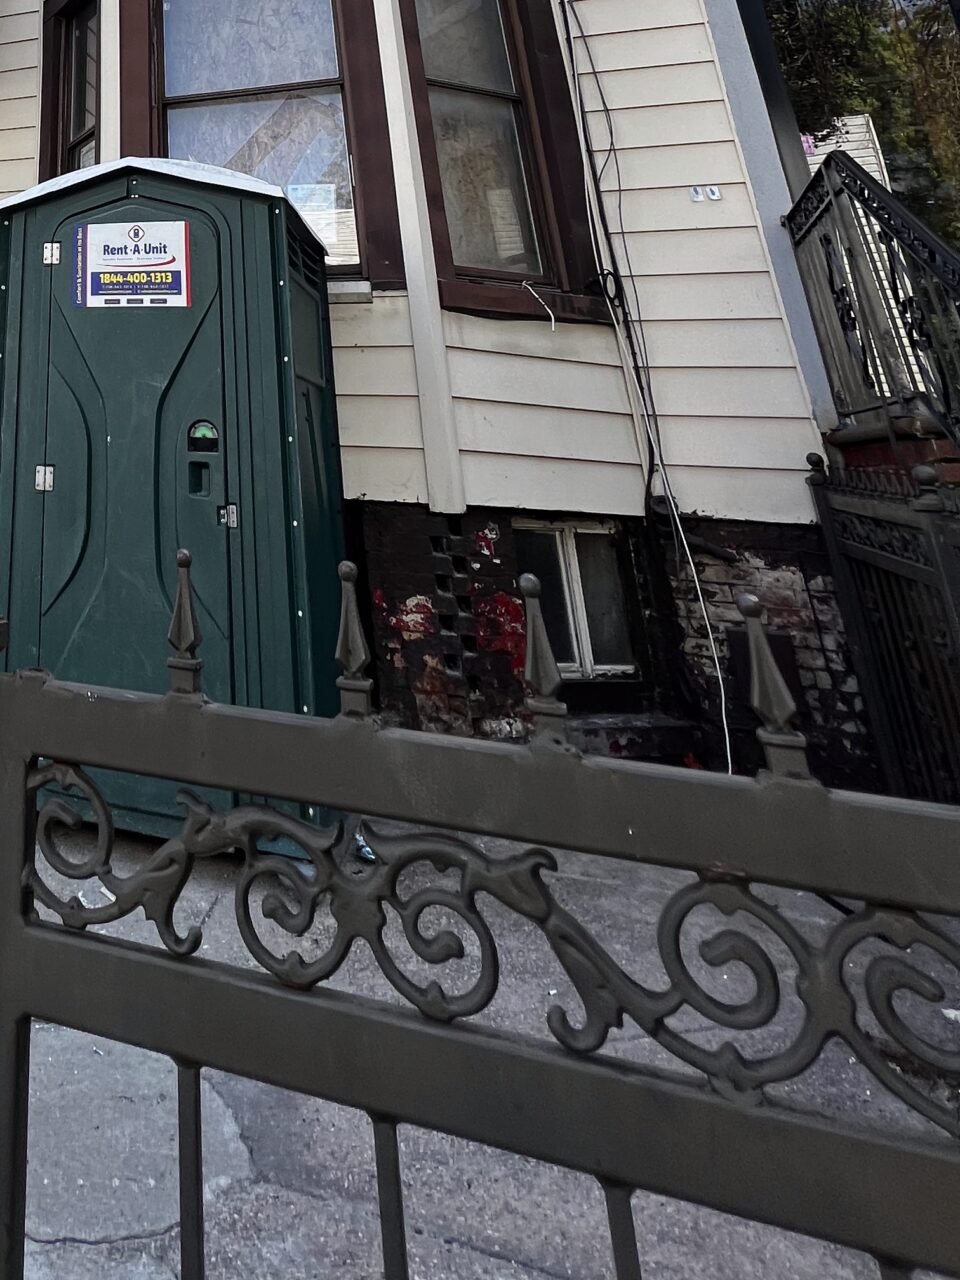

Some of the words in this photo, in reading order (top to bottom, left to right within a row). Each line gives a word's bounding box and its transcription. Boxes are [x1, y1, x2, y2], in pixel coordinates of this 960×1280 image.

[103, 245, 128, 255] Rent
[144, 243, 167, 254] Unit
[100, 272, 172, 283] 1844-400-1313
